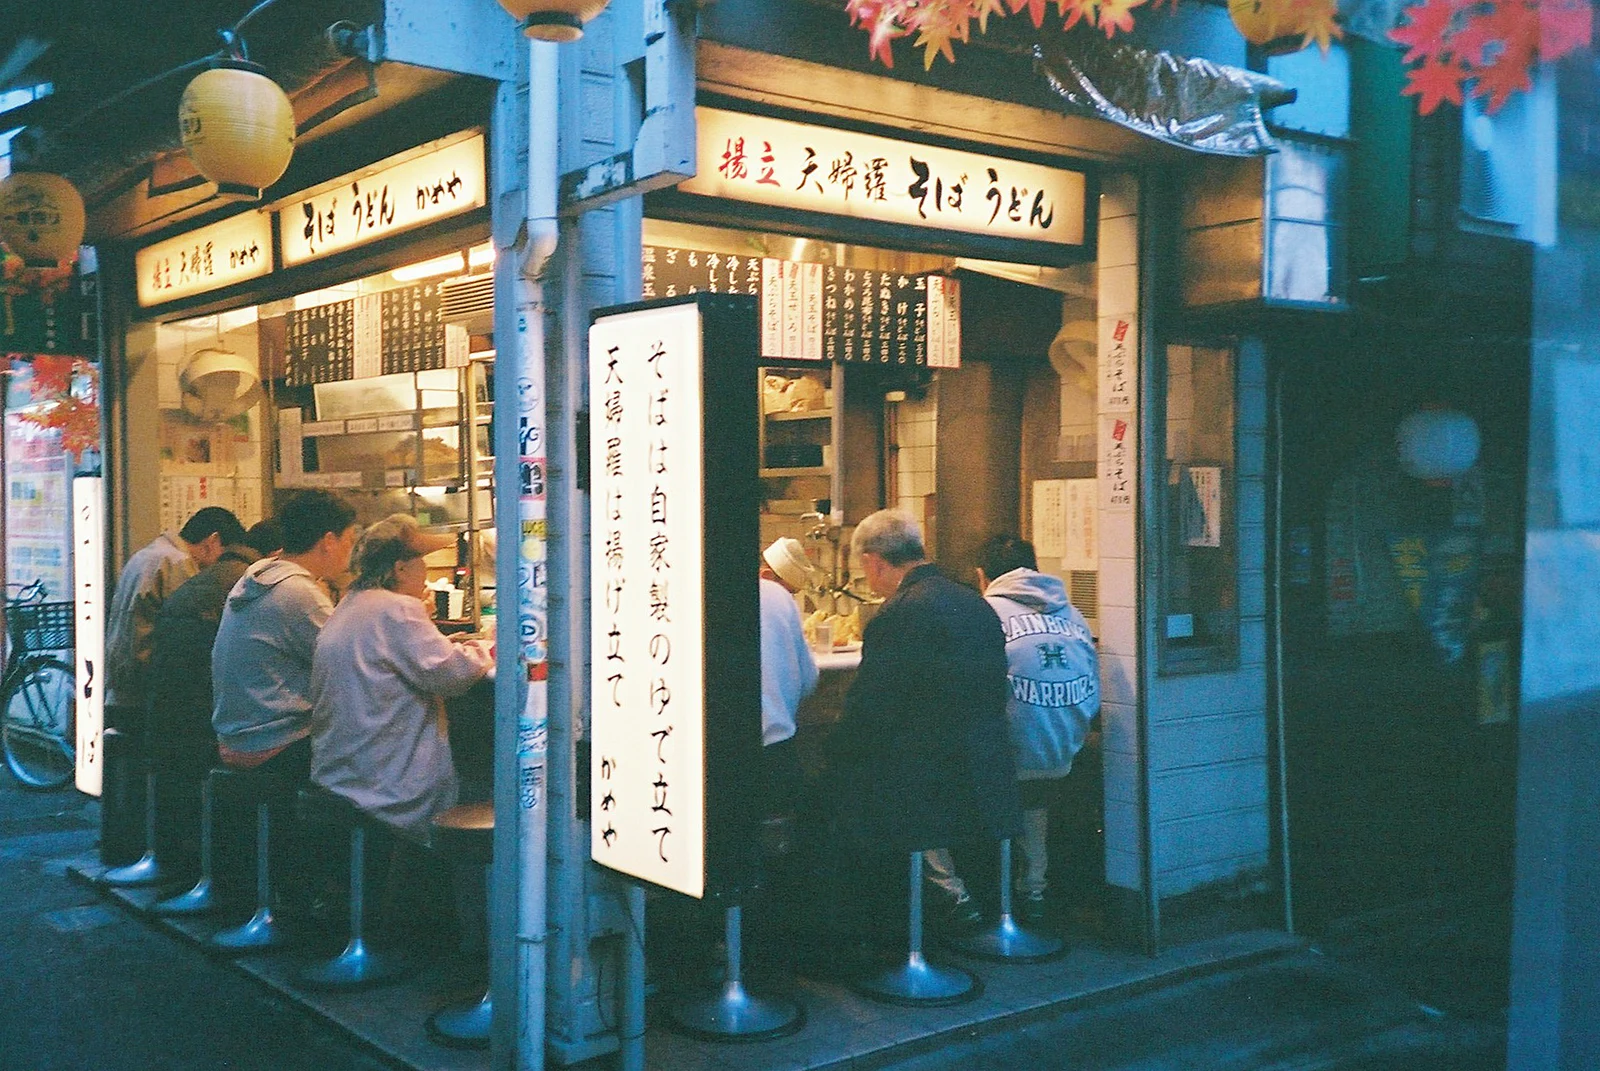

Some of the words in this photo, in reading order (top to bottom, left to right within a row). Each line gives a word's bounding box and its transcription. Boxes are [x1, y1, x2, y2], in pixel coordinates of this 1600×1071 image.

[302, 198, 337, 254] そば
[351, 181, 396, 238] うどん
[416, 170, 463, 211] かめや
[909, 156, 968, 219] そば
[986, 168, 1054, 229] うどん
[648, 340, 673, 863] そばは自家製のゆで立て
